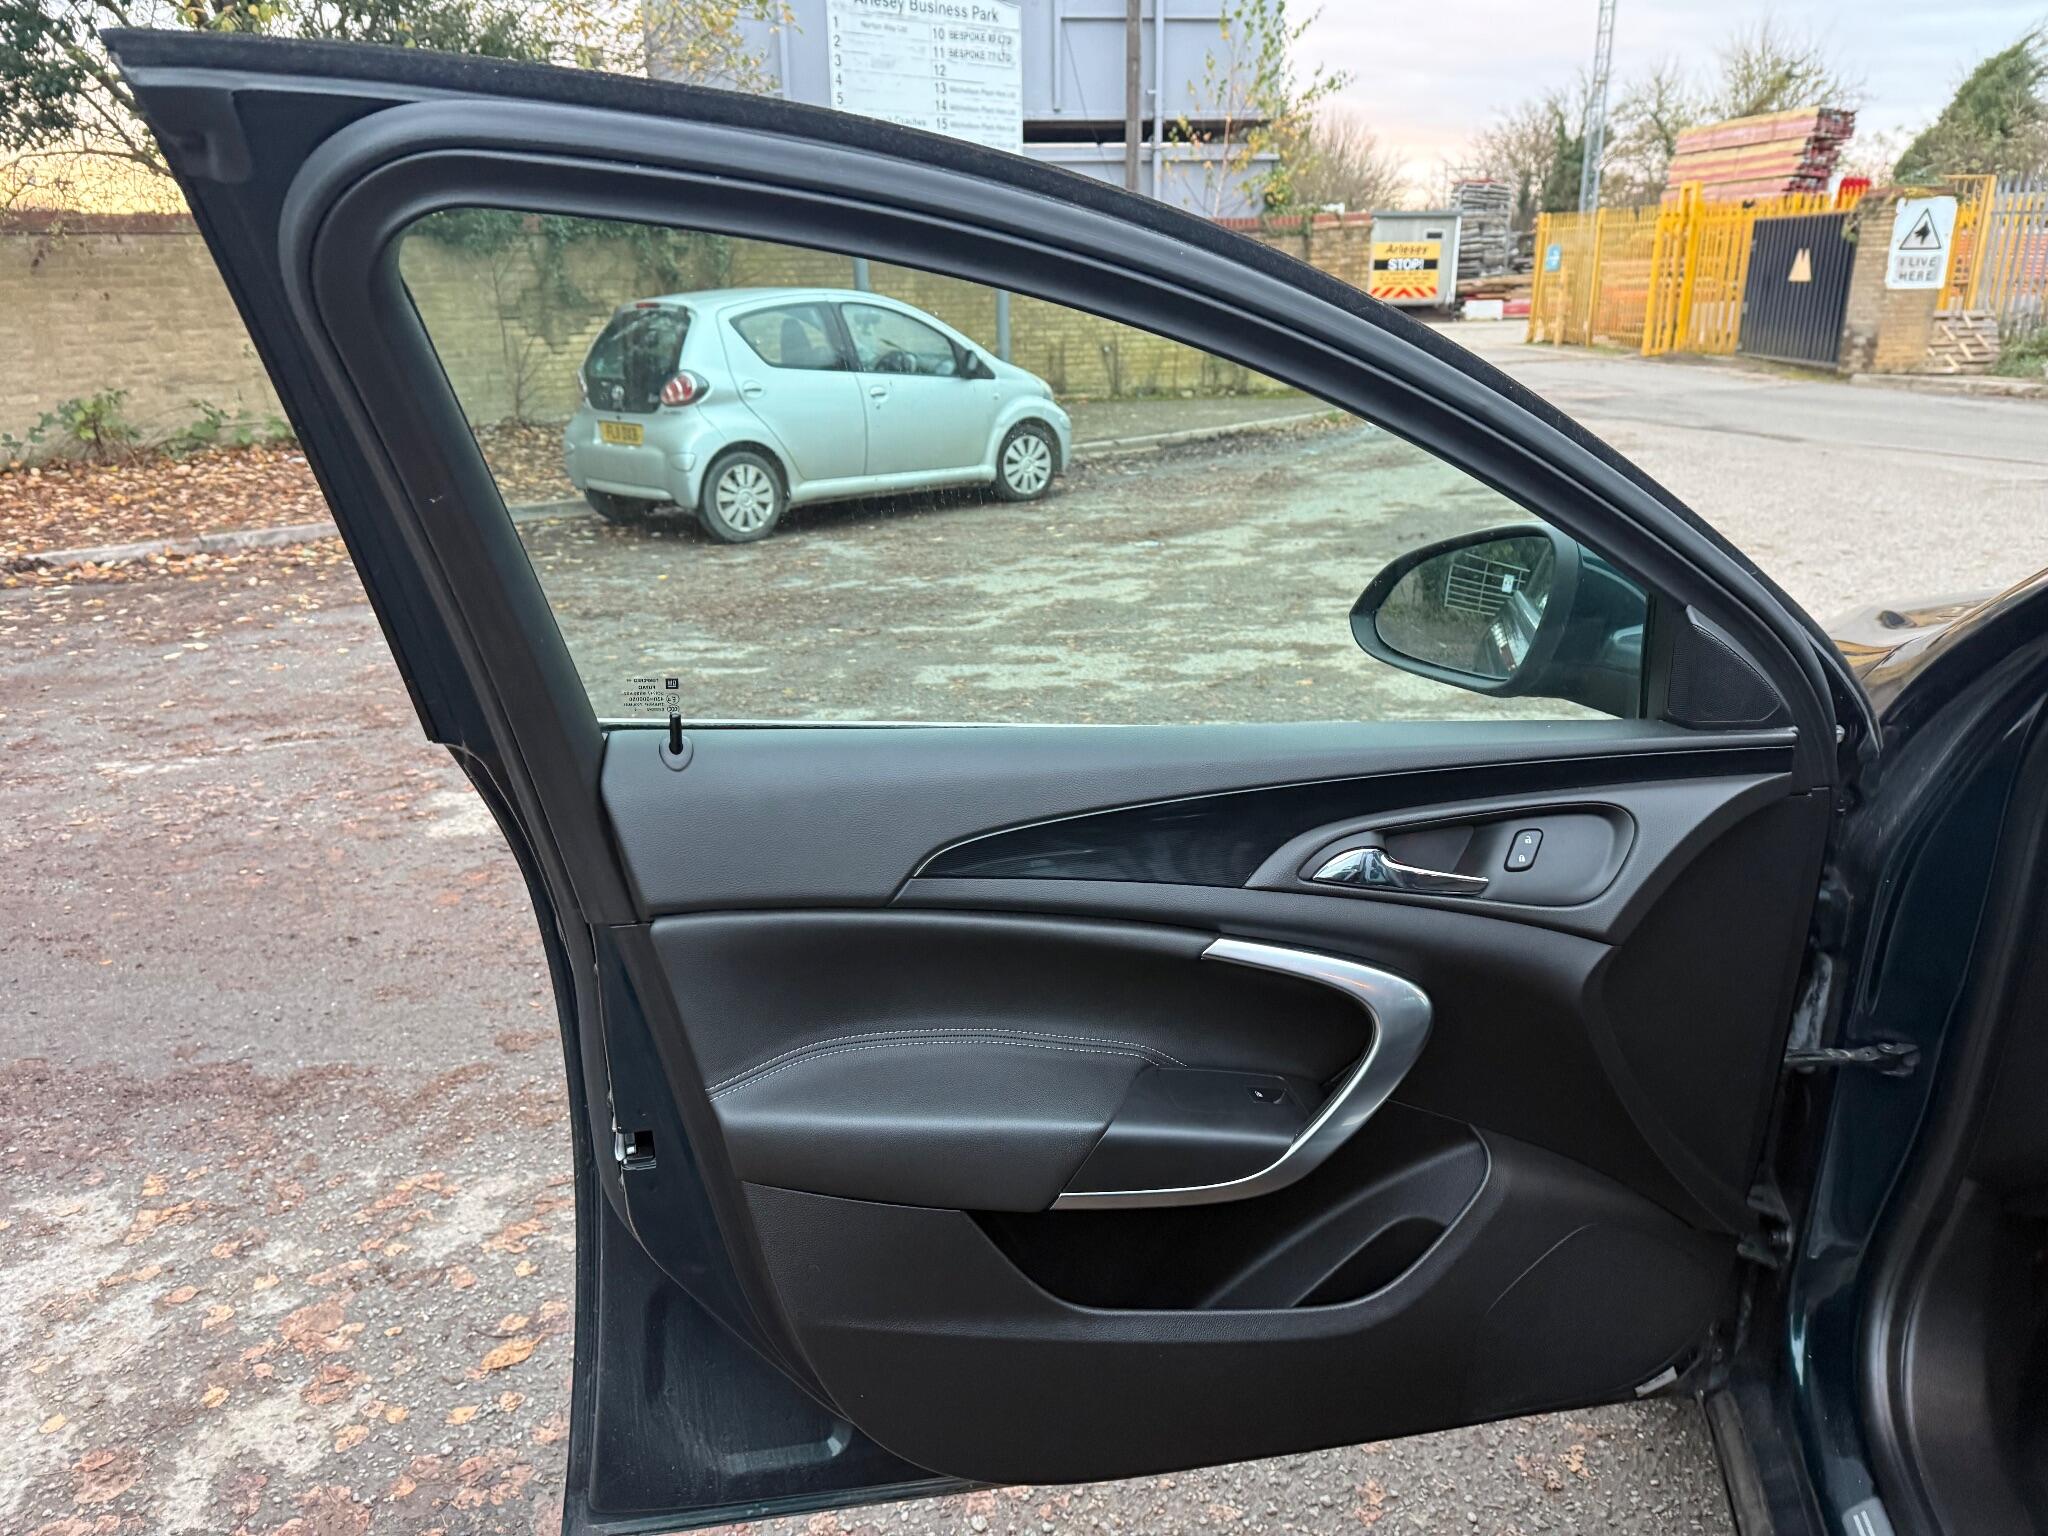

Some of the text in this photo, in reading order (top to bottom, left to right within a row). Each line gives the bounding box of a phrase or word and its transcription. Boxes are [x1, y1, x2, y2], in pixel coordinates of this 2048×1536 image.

[854, 0, 999, 22] esey Business Park
[933, 28, 945, 40] 10
[833, 35, 841, 47] 2
[934, 46, 945, 59] 11
[834, 54, 842, 67] 3
[934, 65, 946, 77] 12
[835, 73, 842, 86] 4
[935, 82, 947, 95] 13
[836, 92, 844, 105] 5
[936, 100, 947, 111] 14
[936, 117, 948, 129] 15
[1909, 256, 1937, 267] LIVE
[1898, 271, 1934, 281] HERE
